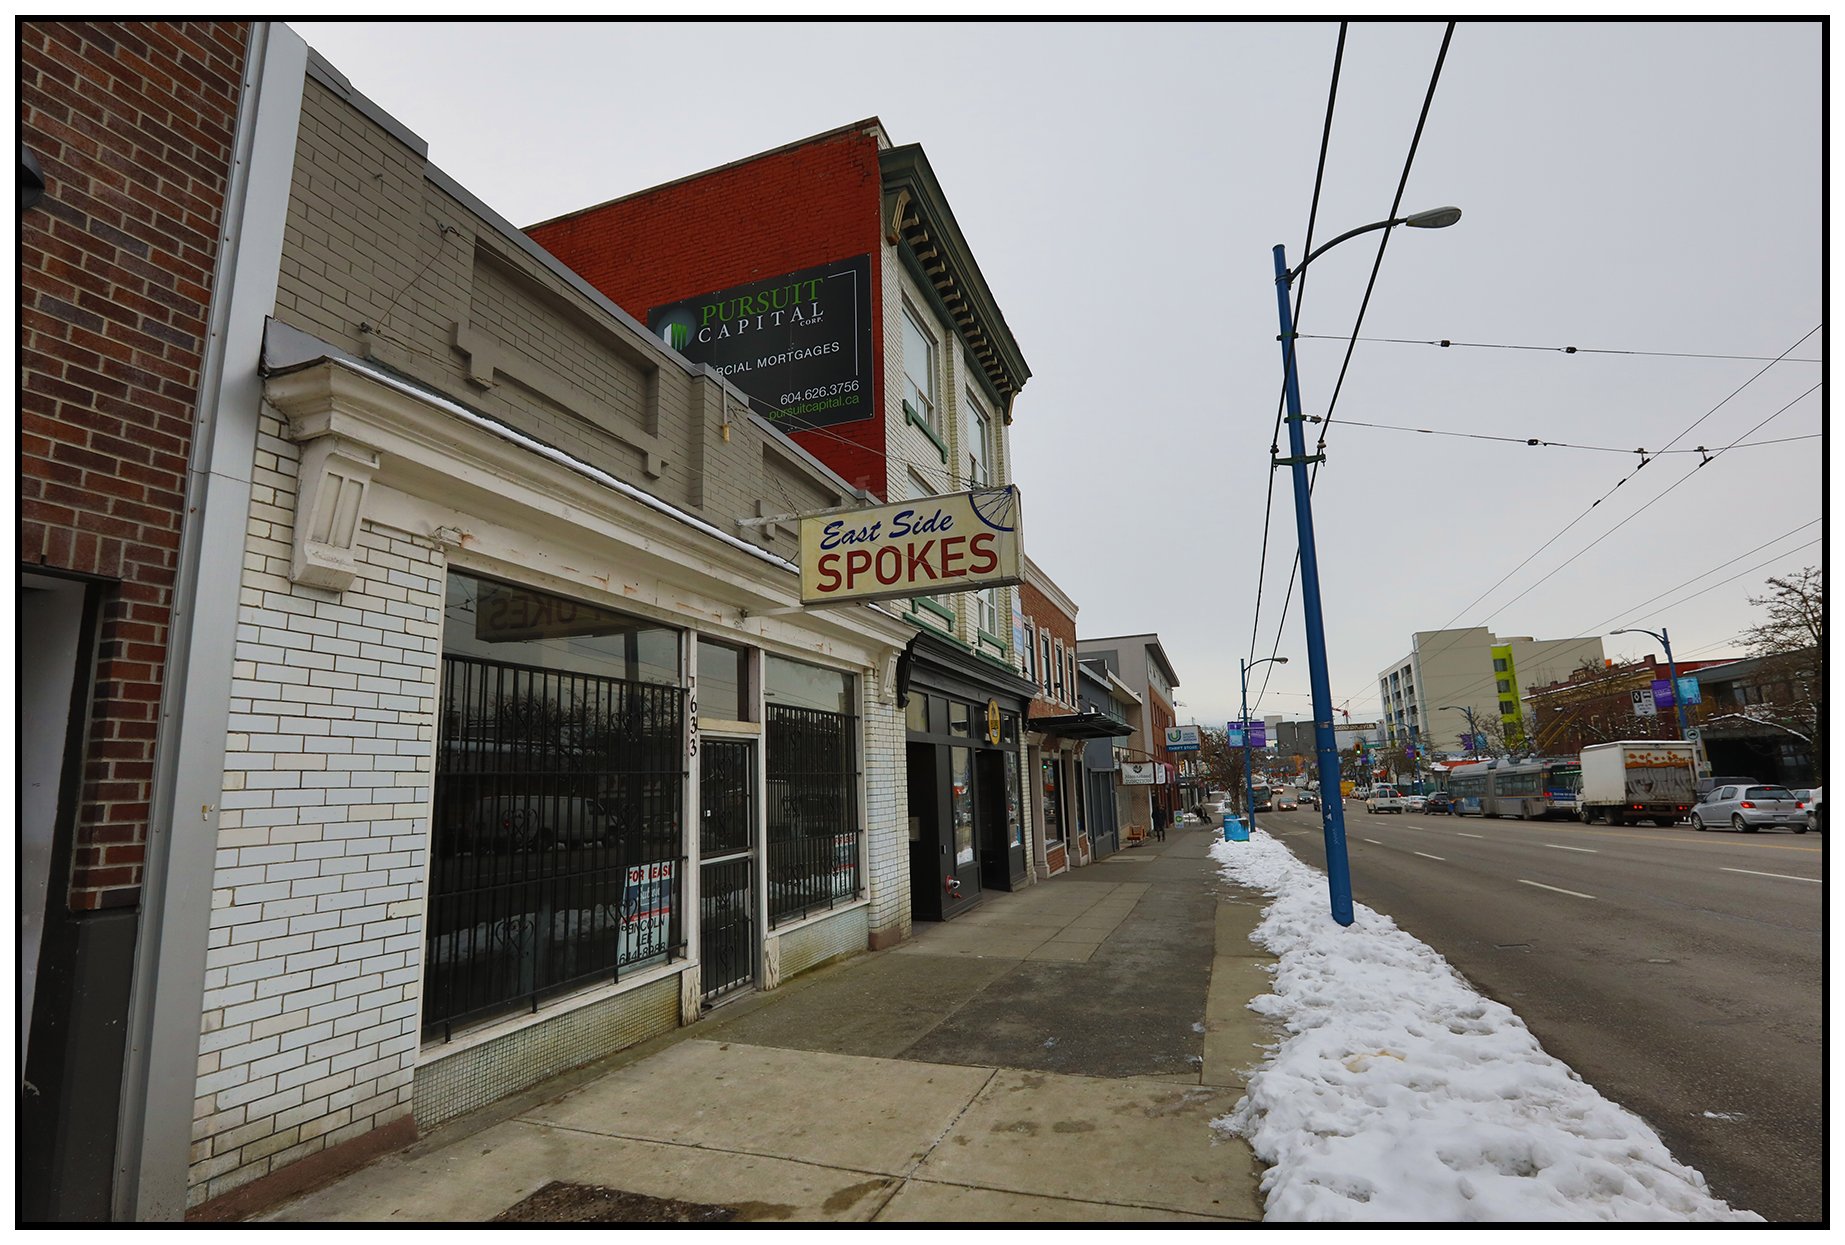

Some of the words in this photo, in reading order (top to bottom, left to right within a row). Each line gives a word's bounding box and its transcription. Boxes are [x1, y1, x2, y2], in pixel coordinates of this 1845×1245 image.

[700, 277, 825, 327] PURSUIT
[799, 316, 825, 327] CORP.
[697, 301, 825, 343] CAPITAL
[712, 361, 753, 377] RCIAL
[756, 341, 841, 368] MORTGAGES
[768, 394, 861, 421] pursuitcapital.ca
[780, 380, 860, 406] 604.626.3756
[820, 519, 881, 550] East
[888, 508, 954, 538] Side
[816, 532, 998, 592] SPOKES
